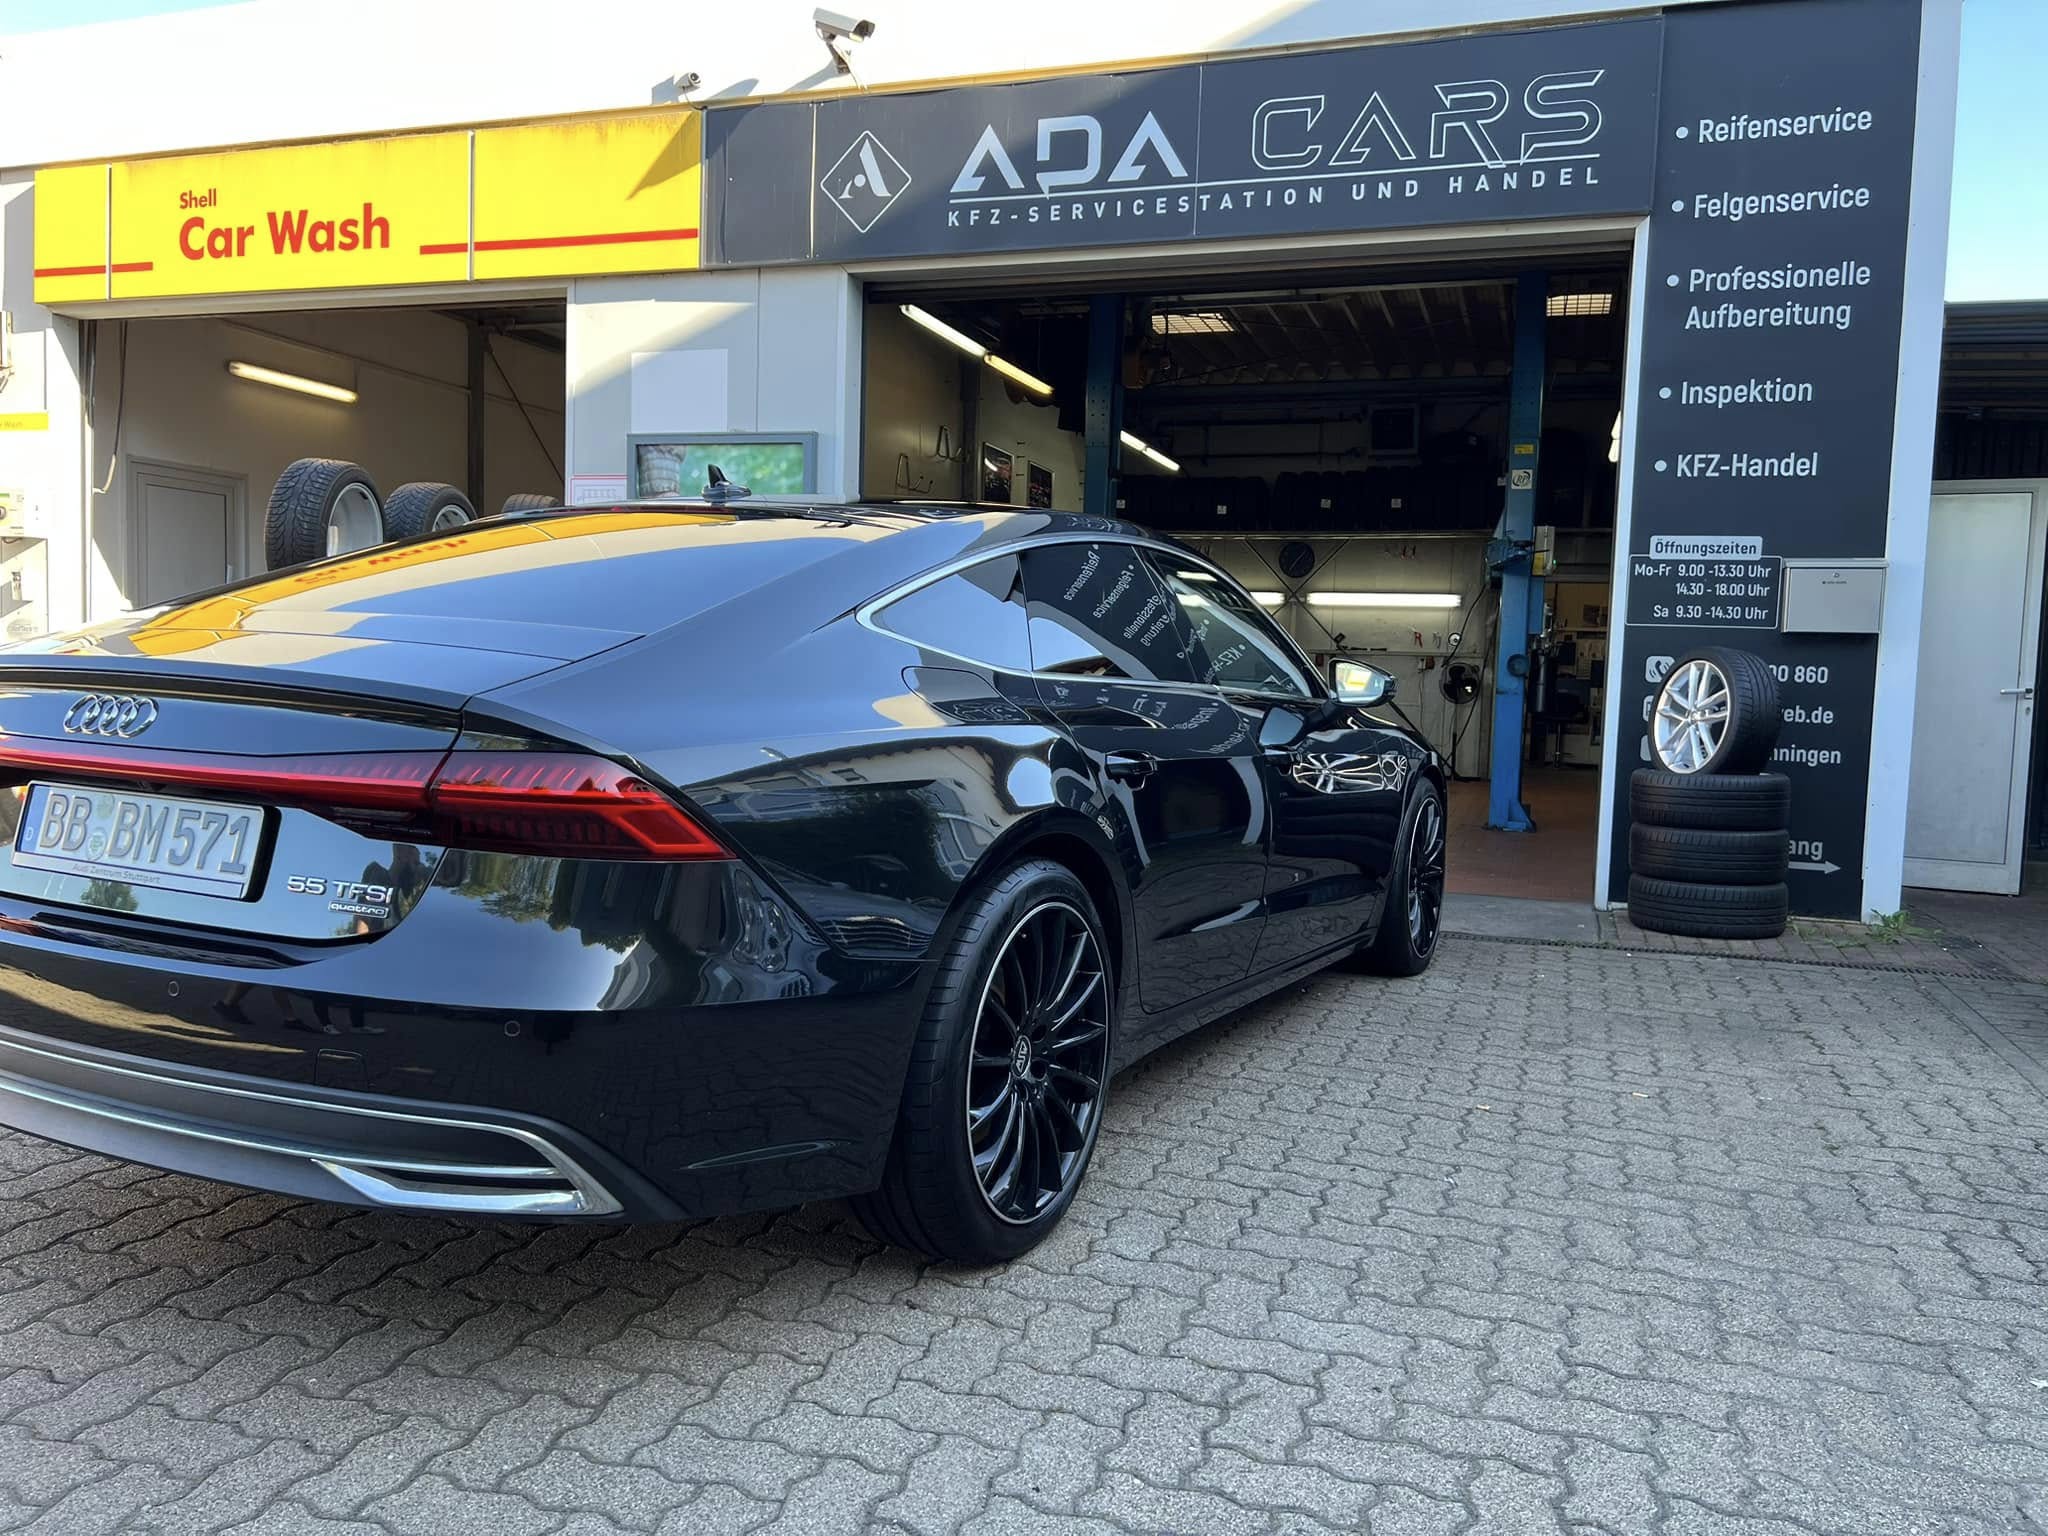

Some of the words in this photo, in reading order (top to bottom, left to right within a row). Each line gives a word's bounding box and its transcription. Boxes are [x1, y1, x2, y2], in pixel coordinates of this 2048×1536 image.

[950, 111, 1188, 200] ADA
[1252, 69, 1605, 168] CARS
[1699, 107, 1873, 144] Reifenservice
[179, 188, 217, 209] Shell
[948, 186, 1324, 227] KFZ-SERVICESTATION
[1352, 179, 1419, 201] UND
[1449, 167, 1600, 194] HANDEL
[1694, 184, 1871, 223] Felgenservice
[179, 216, 255, 261] Car
[267, 202, 390, 255] Wash
[1689, 261, 1871, 292] Professionelle
[1685, 301, 1851, 330] Aufbereitung
[1681, 378, 1813, 408] Inspektion
[1676, 452, 1818, 477] KFZ-Handel
[1655, 538, 1757, 556] Öffnungszeiten
[1634, 564, 1672, 577] Mo-Fr
[1678, 564, 1704, 577] 9.00
[1748, 565, 1771, 578] Uhr
[1675, 582, 1704, 595] 14.30
[1715, 583, 1744, 596] 18.00
[1748, 584, 1770, 596] Uhr
[1653, 605, 1669, 617] Sa
[1676, 605, 1701, 618] 9.30
[1744, 607, 1768, 620] Uhr
[1794, 666, 1829, 684] 860
[1782, 705, 1834, 724] eb.de
[40, 793, 92, 851] BB
[287, 876, 327, 896] 55
[332, 880, 394, 904] TFSI
[330, 902, 386, 915] quattro
